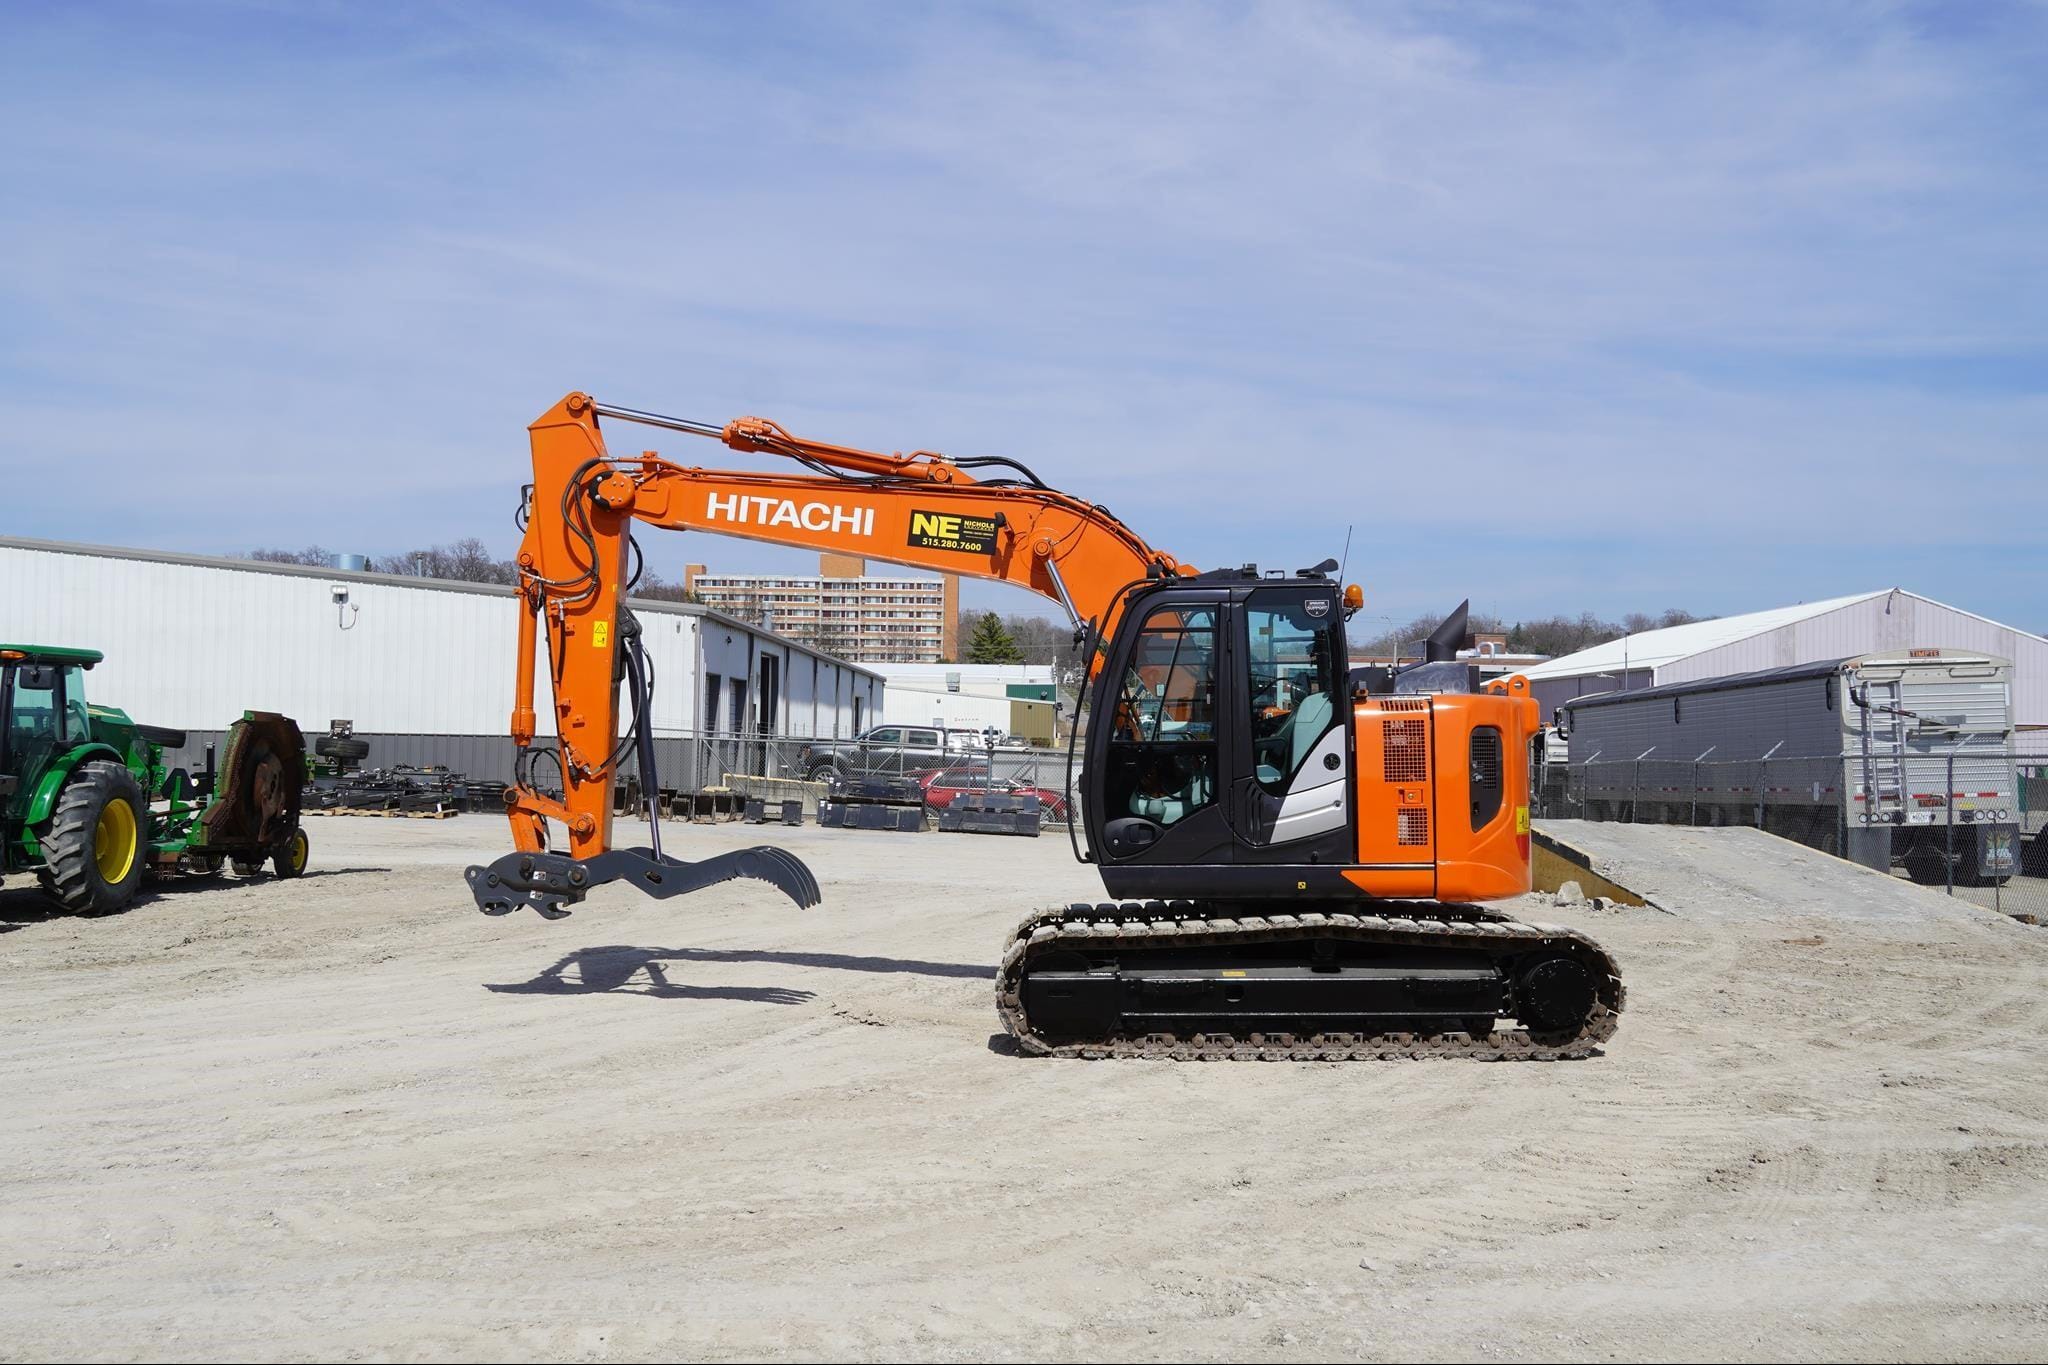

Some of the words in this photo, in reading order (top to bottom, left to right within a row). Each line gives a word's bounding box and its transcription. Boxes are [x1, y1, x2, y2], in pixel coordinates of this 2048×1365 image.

[706, 492, 875, 536] HITACHI
[912, 513, 962, 539] NE
[964, 520, 995, 530] NICHOLS
[922, 537, 982, 551] 515.280.7600
[1910, 650, 1940, 658] TIMPTE
